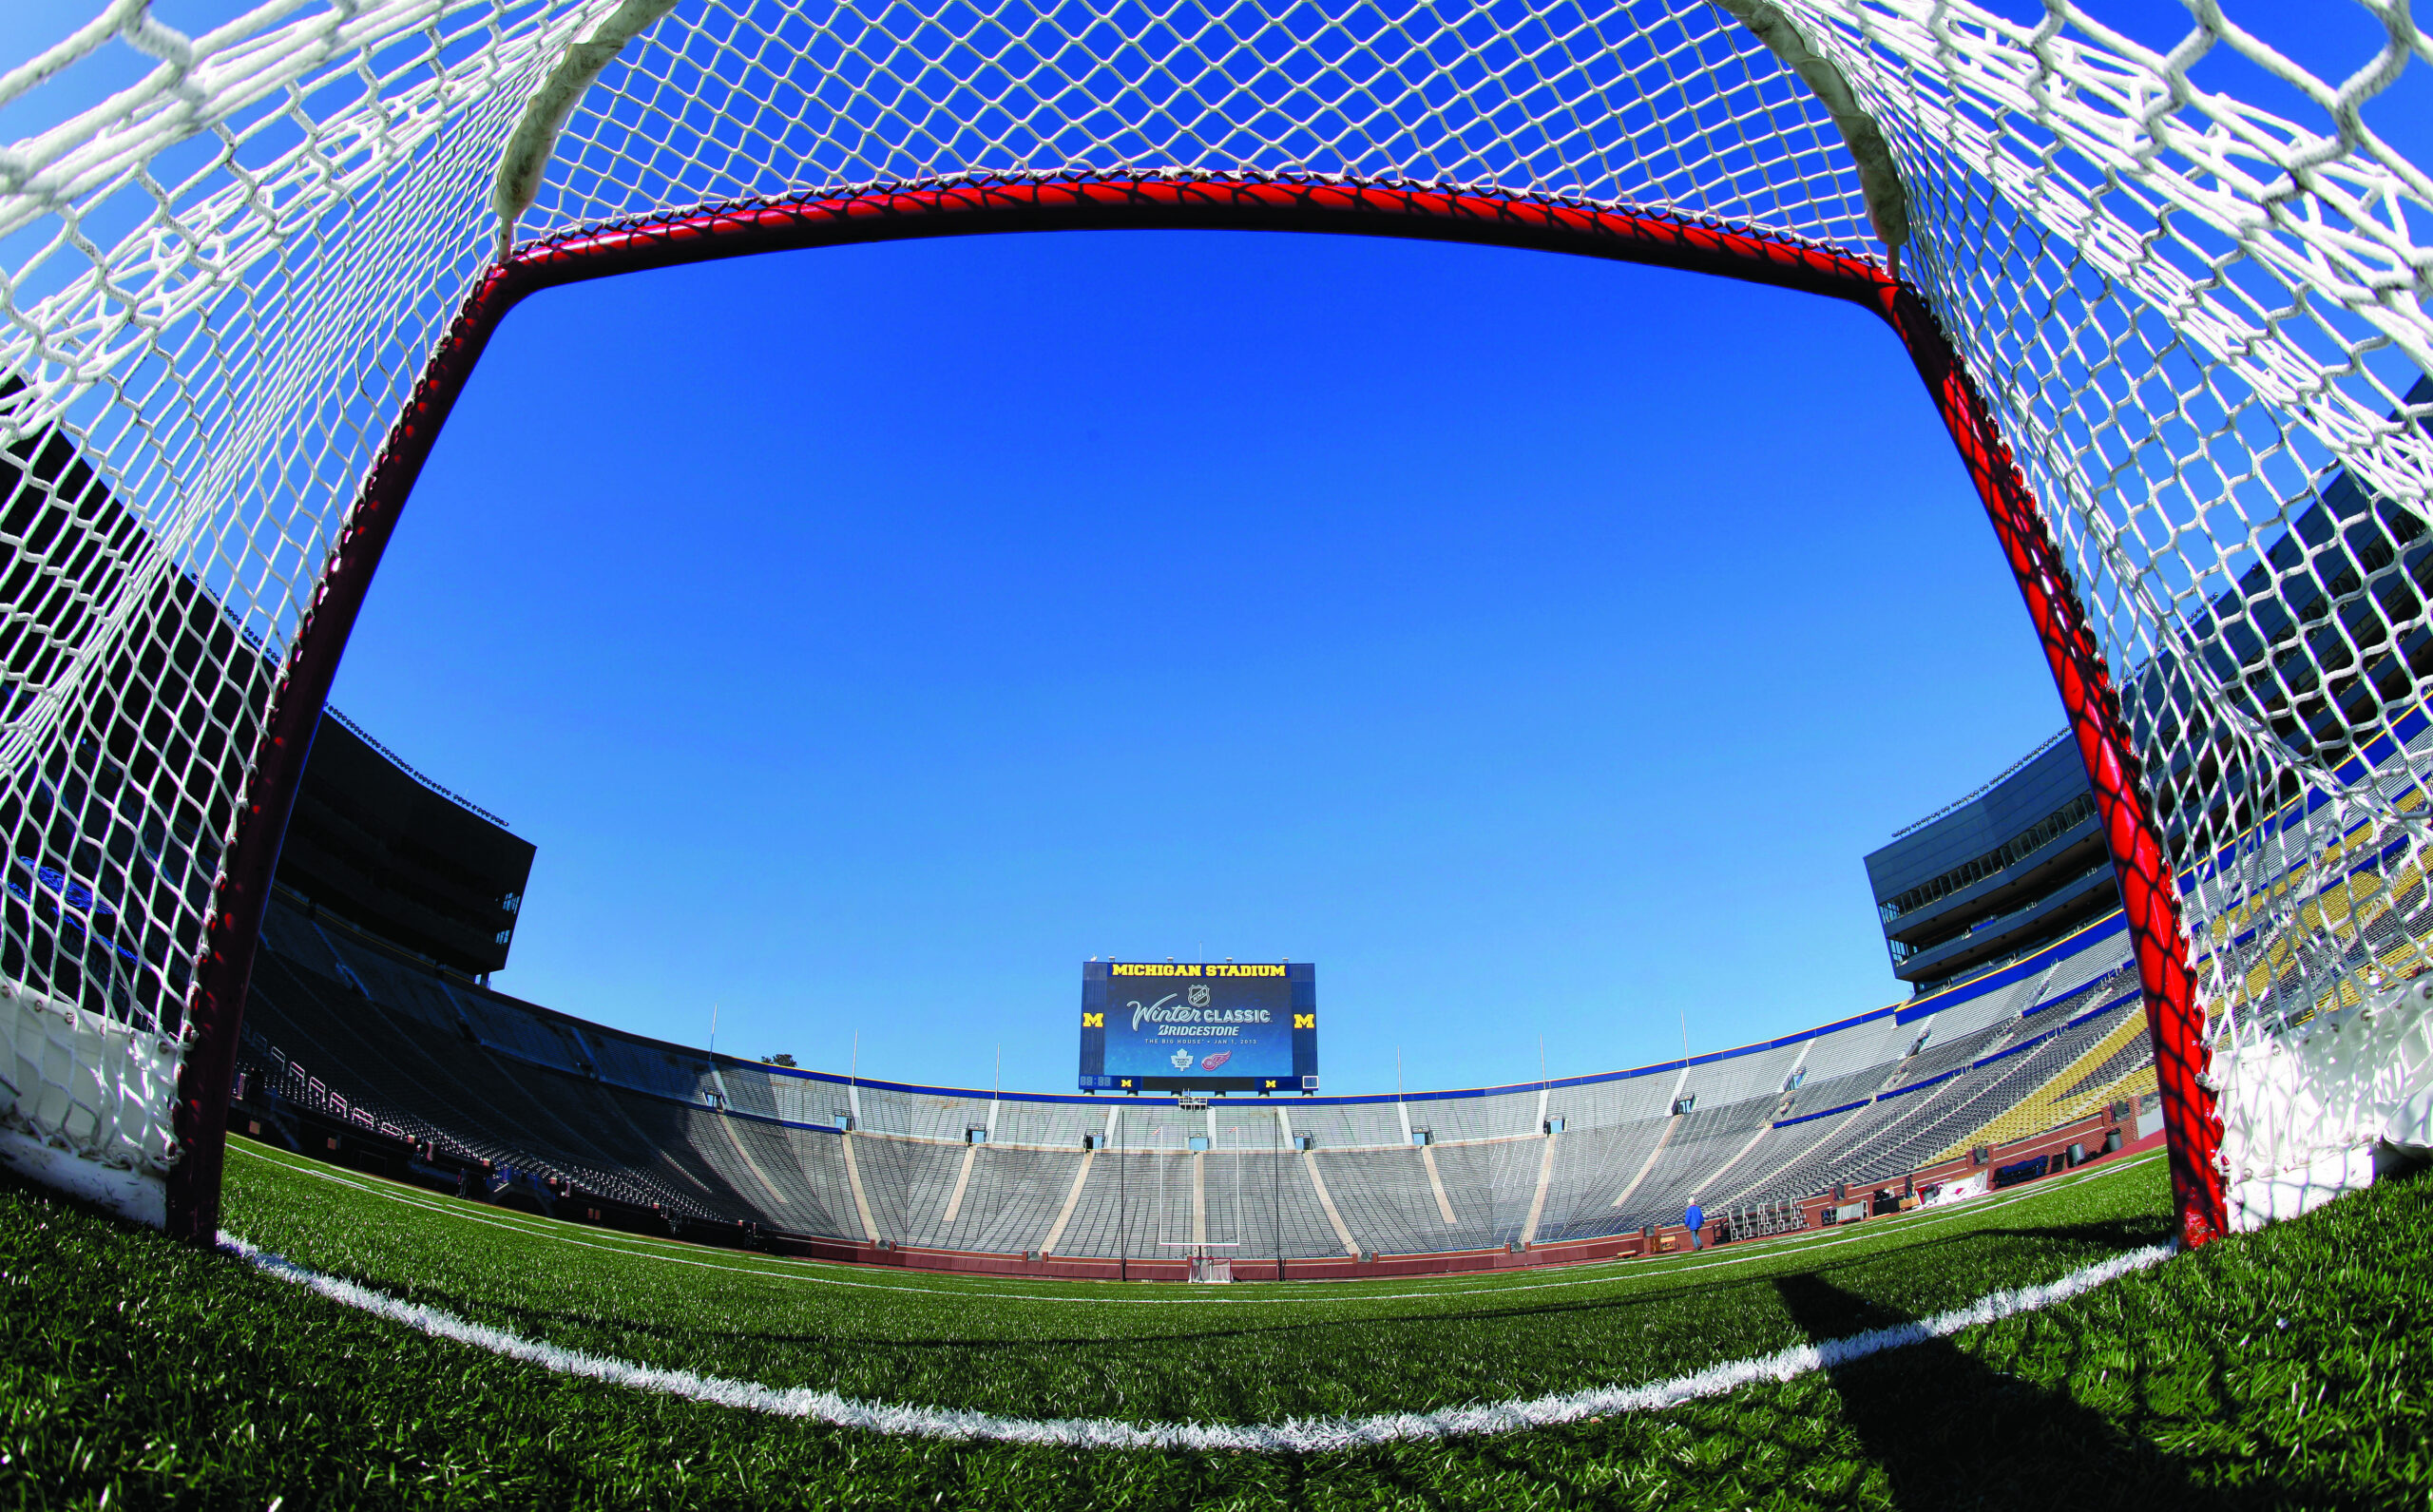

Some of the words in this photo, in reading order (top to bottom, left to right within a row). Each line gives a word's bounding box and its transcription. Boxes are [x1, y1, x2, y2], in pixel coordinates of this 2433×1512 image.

[1112, 964, 1201, 977] MICHIGAN
[1205, 965, 1286, 977] STADIUM
[1193, 990, 1206, 1003] NHL
[1126, 993, 1201, 1032] Winter
[1203, 1009, 1271, 1024] CLASSIC
[1082, 1013, 1103, 1027] M
[1293, 1014, 1314, 1028] M
[1158, 1024, 1239, 1036] BRIDGESTONE
[1121, 1079, 1132, 1087] M
[1265, 1080, 1276, 1088] M
